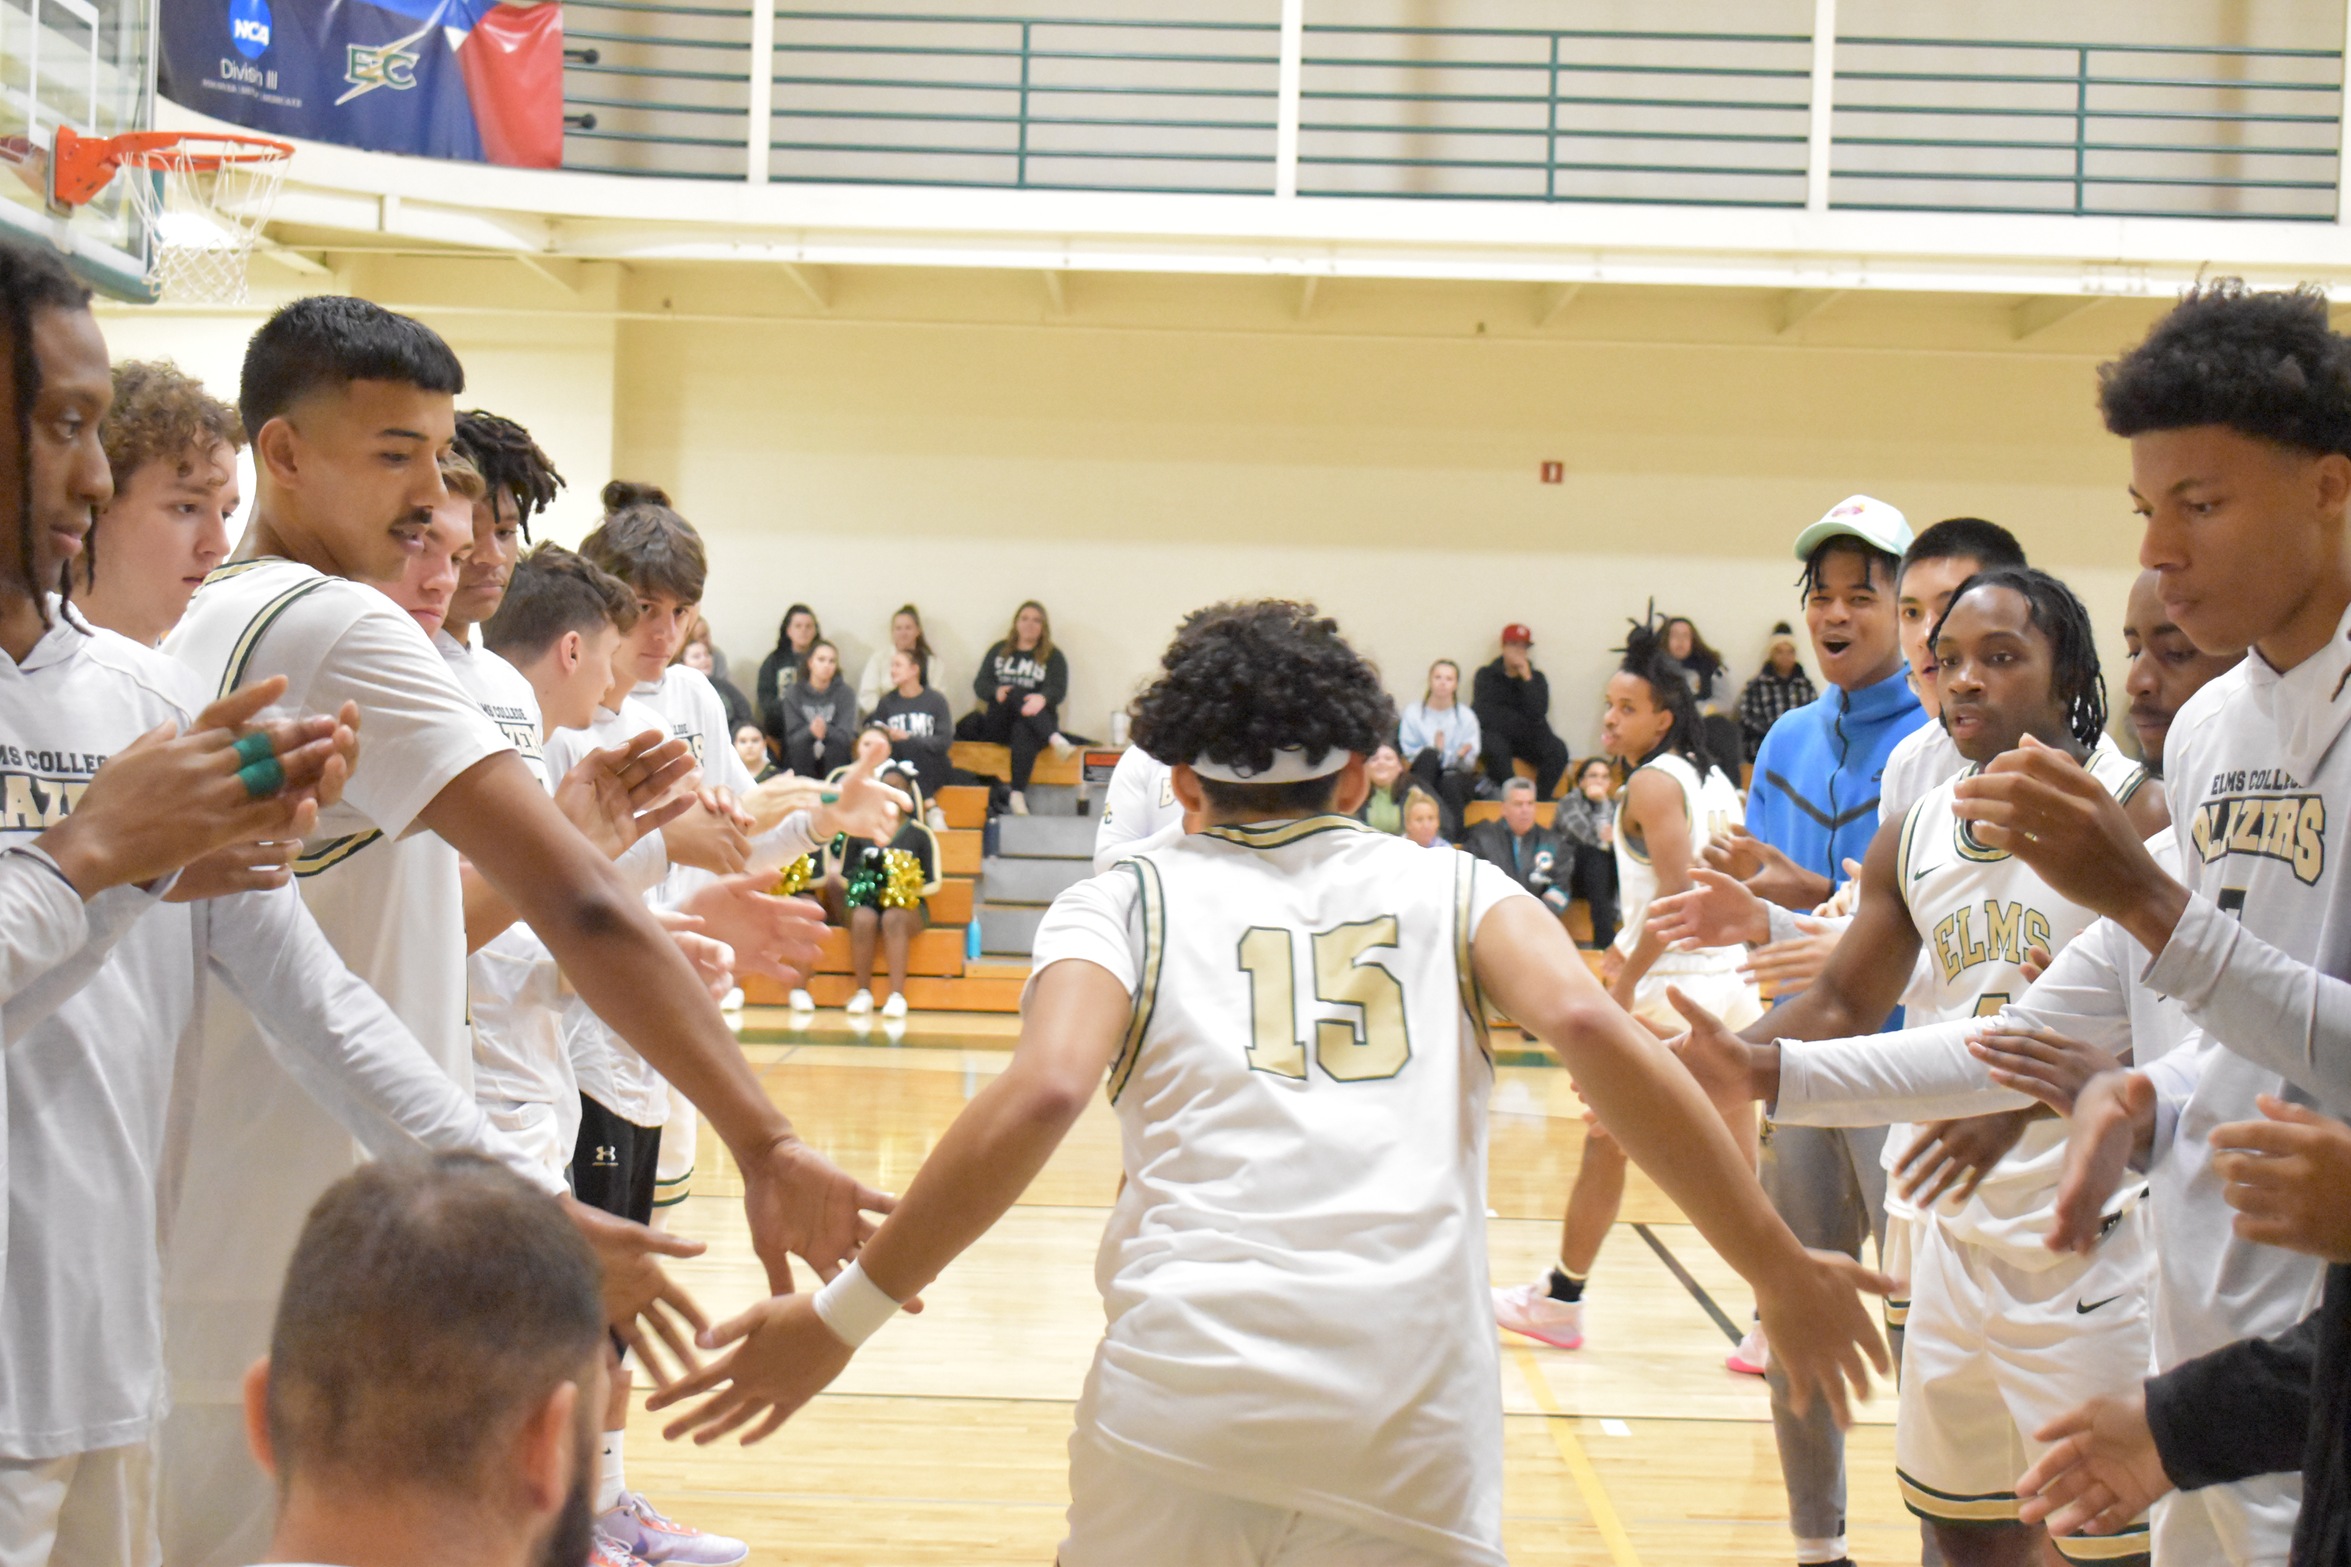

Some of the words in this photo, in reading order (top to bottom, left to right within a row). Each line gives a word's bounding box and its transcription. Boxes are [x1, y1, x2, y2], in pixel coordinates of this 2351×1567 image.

[2211, 770, 2246, 796] ELMS
[1933, 899, 2051, 986] ELMS
[1237, 913, 1412, 1083] 15
